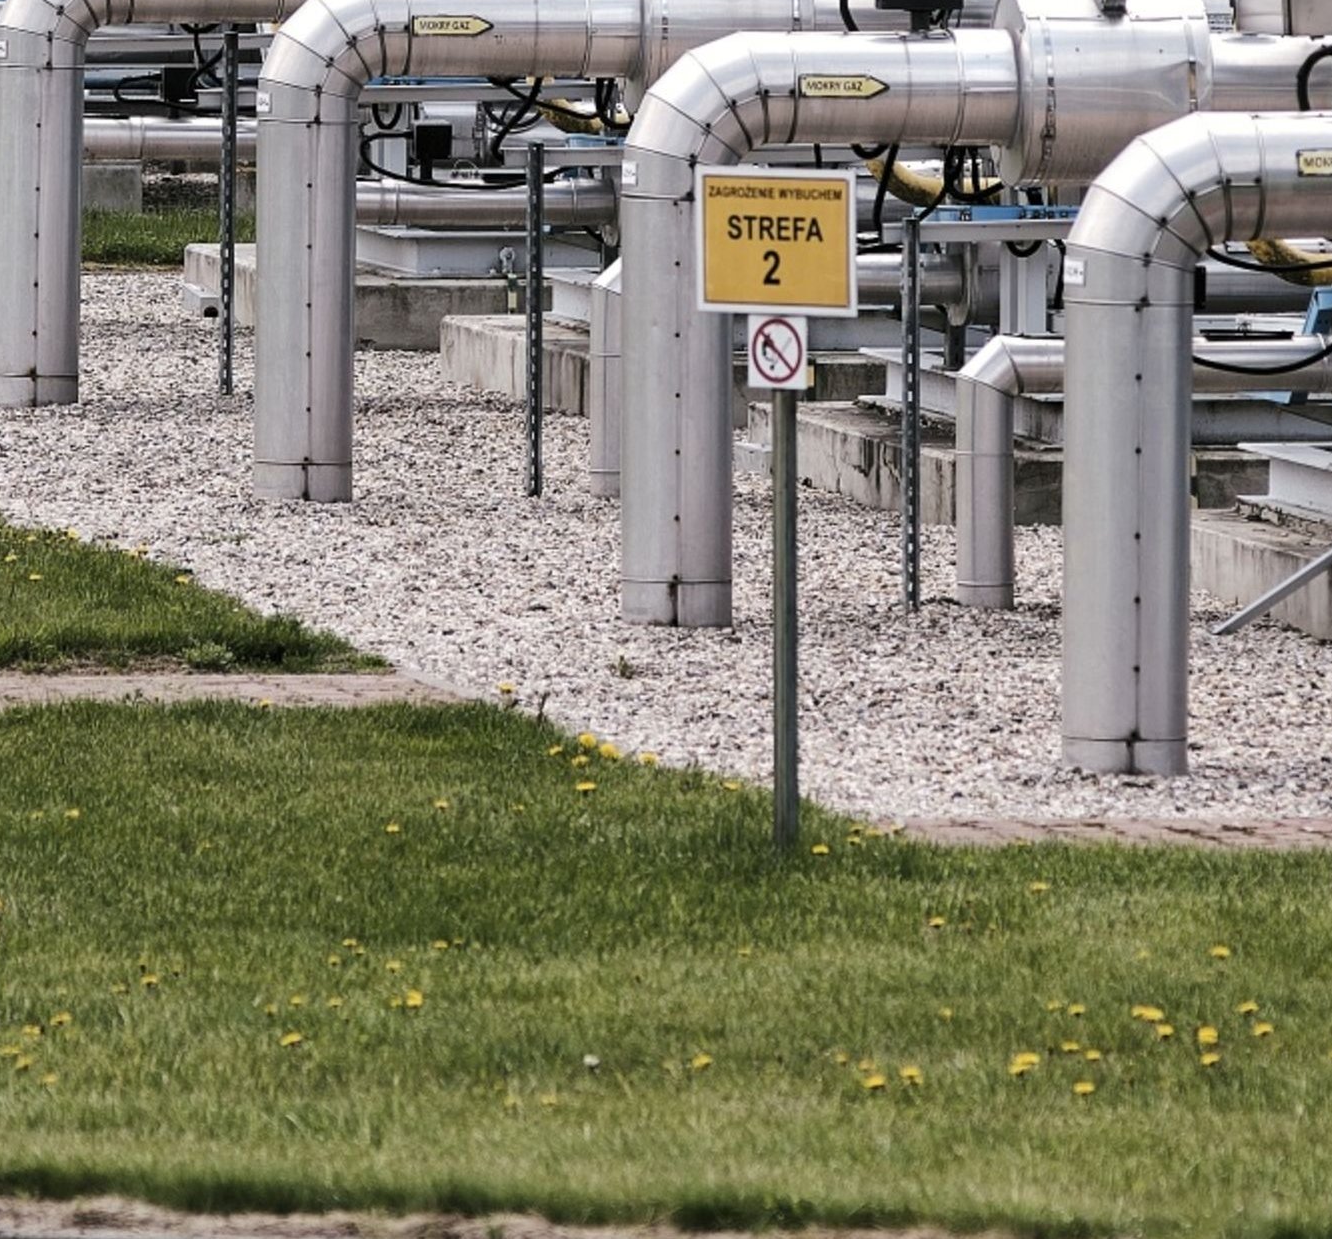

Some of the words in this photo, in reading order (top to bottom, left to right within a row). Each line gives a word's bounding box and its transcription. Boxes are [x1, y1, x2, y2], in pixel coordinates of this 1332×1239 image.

[843, 81, 863, 91] GAZ
[708, 185, 776, 199] ZAGROŻENIE
[778, 187, 843, 201] WYBUCHEM
[727, 214, 824, 242] STREFA
[762, 250, 781, 286] 2
